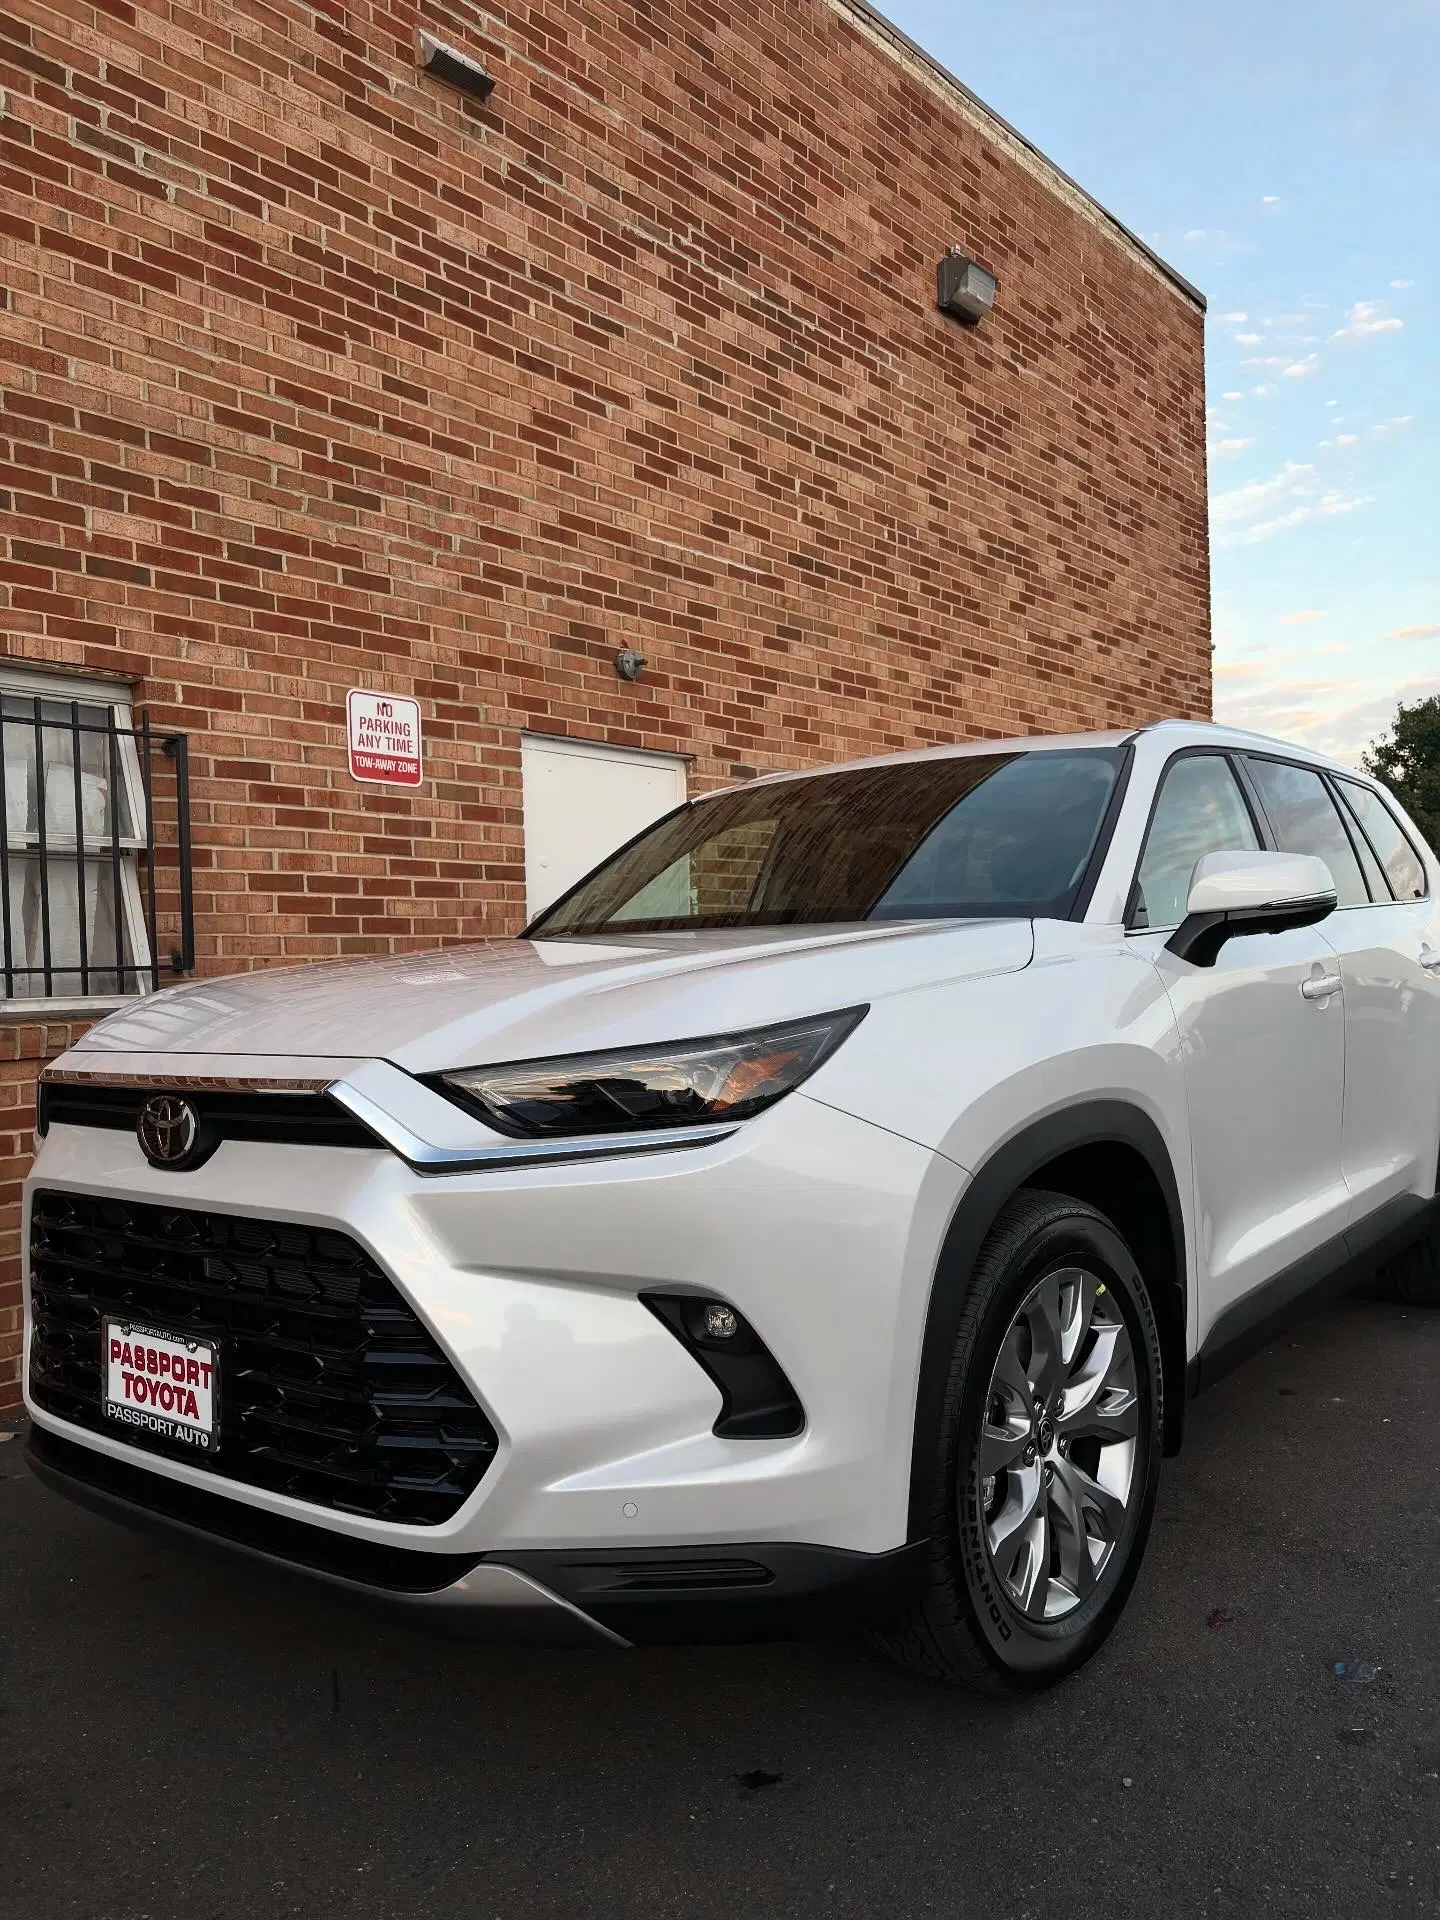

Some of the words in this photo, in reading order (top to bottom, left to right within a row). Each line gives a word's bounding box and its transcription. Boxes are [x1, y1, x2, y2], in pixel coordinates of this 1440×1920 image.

[376, 702, 393, 717] NO
[359, 716, 411, 737] PARKING
[358, 733, 381, 749] ANY
[385, 737, 413, 753] TIME
[354, 755, 396, 772] TOW-AWAY
[397, 761, 418, 774] ZONE
[110, 1338, 213, 1389] PASSPORT
[121, 1371, 200, 1420] TOYOTA
[107, 1403, 175, 1436] PASSPORT
[175, 1425, 209, 1447] AUTO
